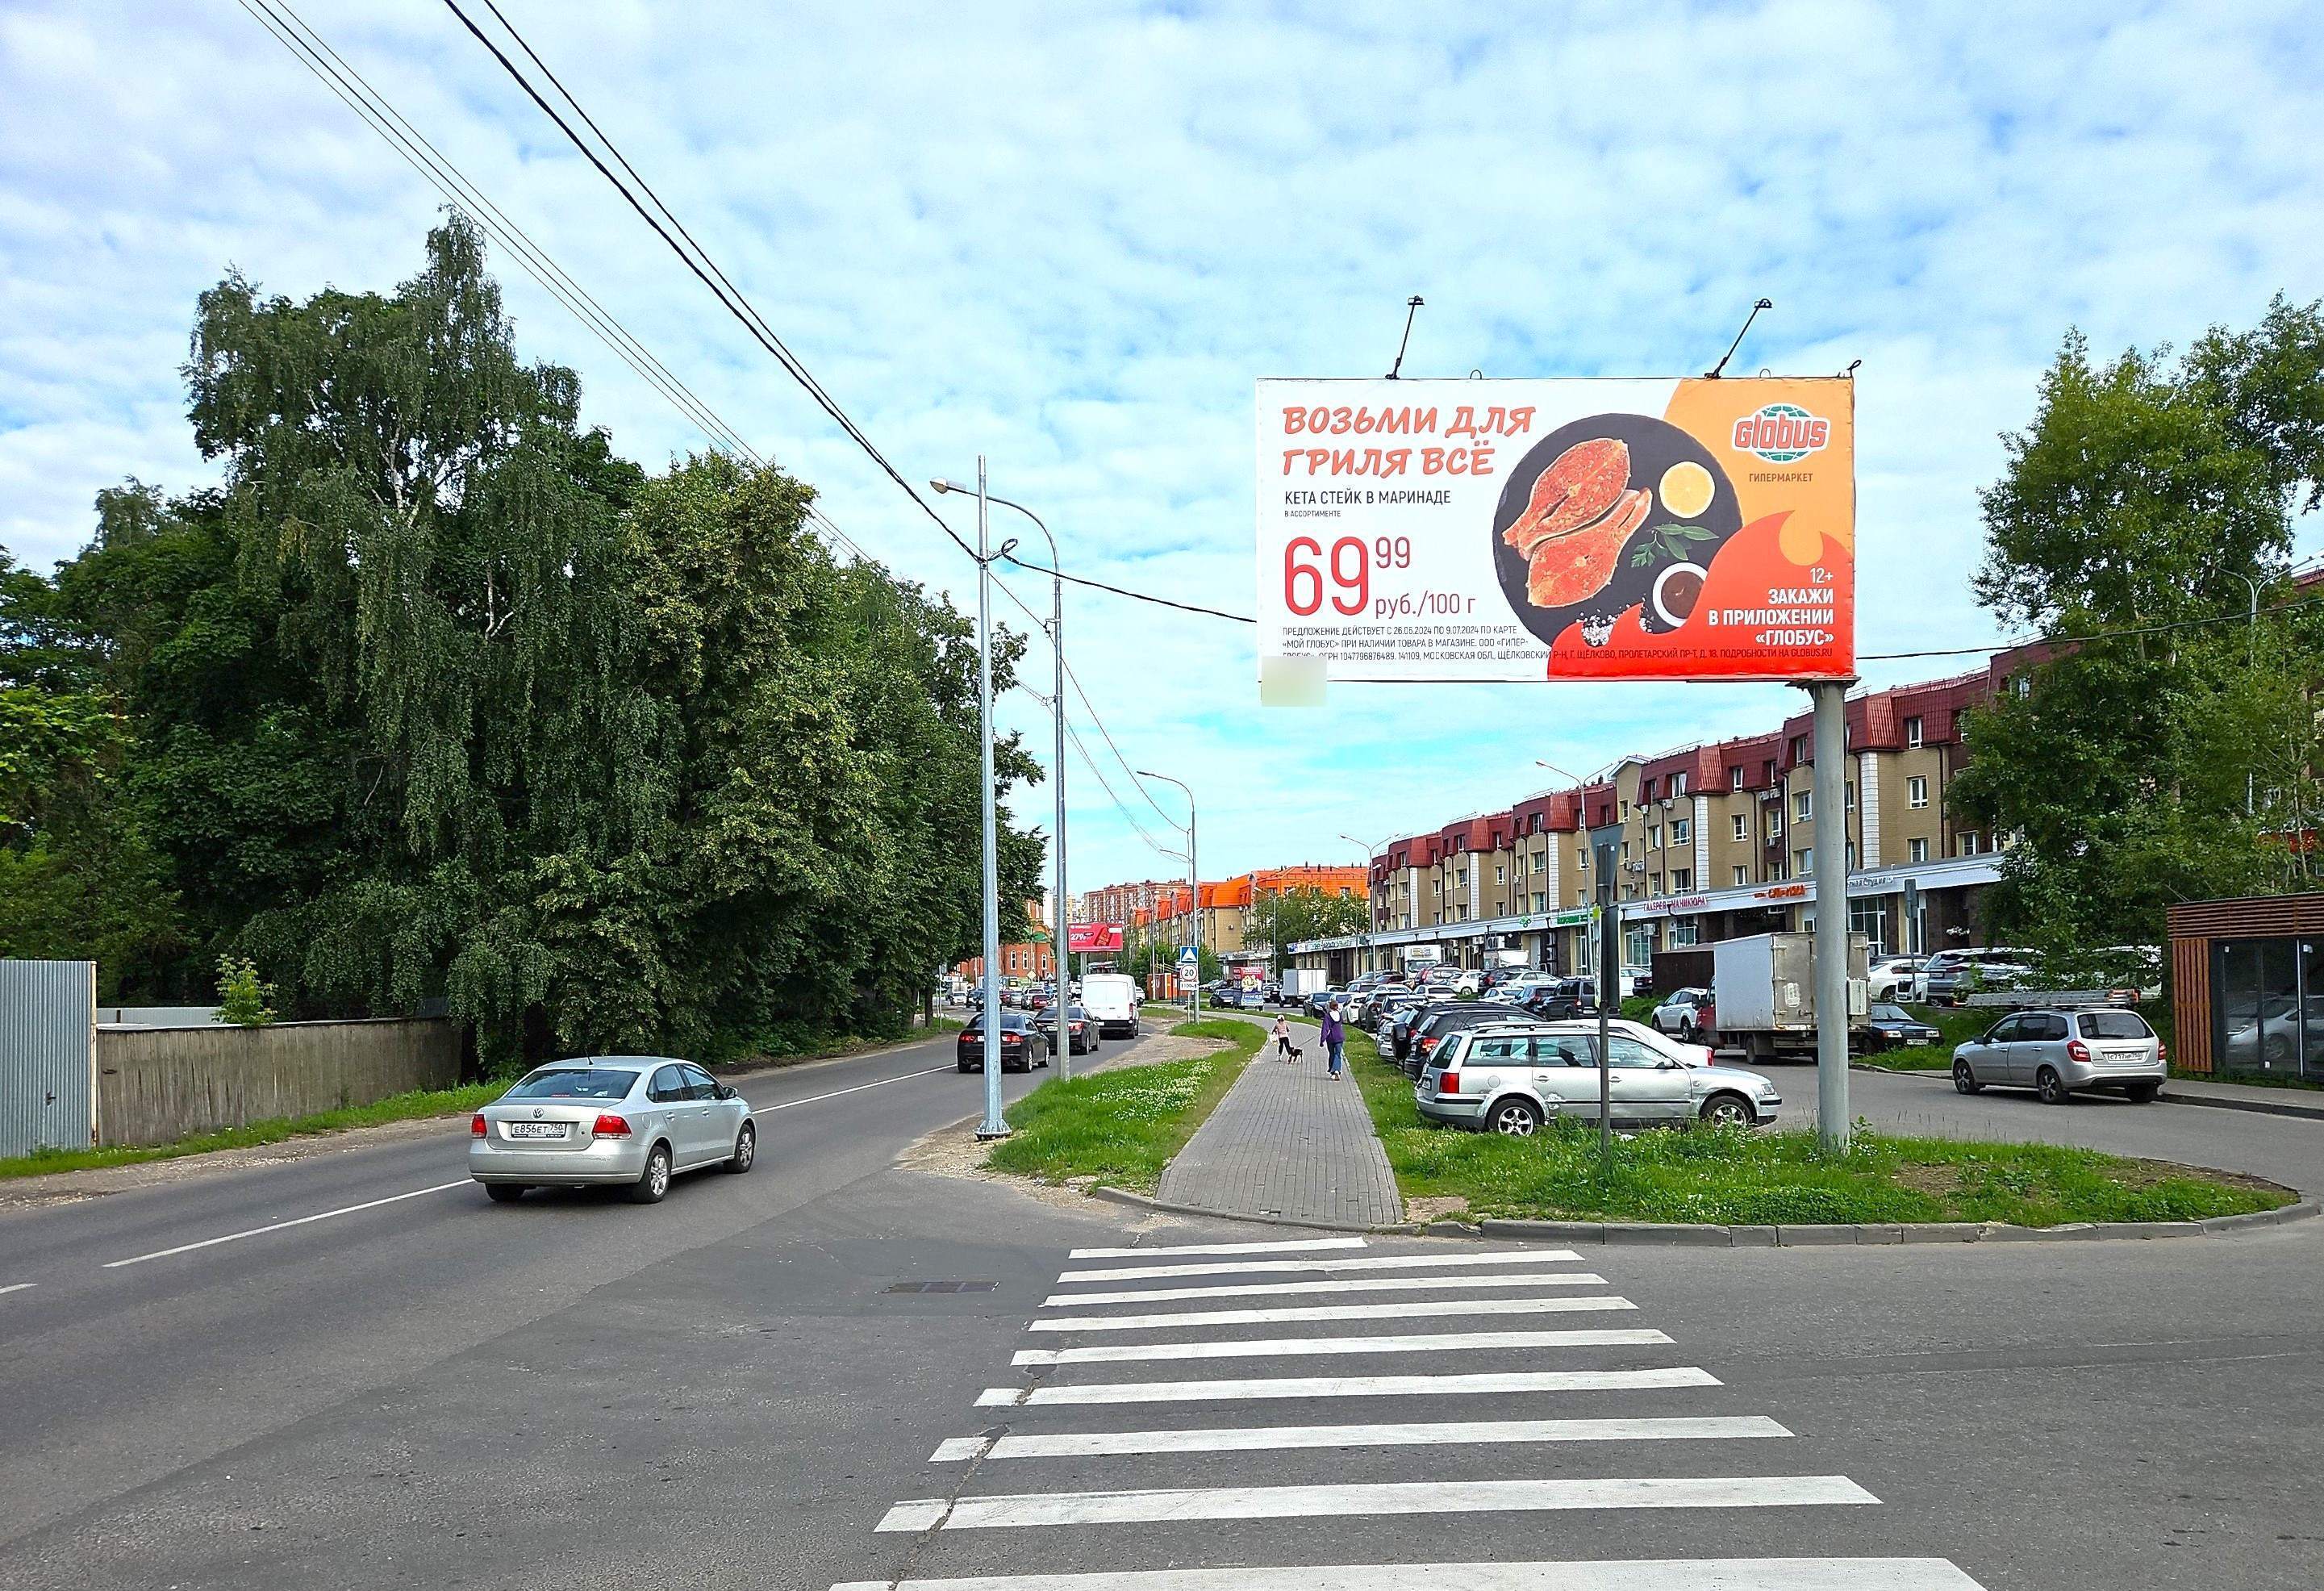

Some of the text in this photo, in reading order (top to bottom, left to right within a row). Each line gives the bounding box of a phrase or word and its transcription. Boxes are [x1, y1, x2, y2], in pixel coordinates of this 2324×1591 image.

[1283, 406, 1537, 439] ВОЗЬМИ ДЛЯ
[1283, 441, 1496, 478] ГРИЛЯ ВСЁ
[1749, 473, 1813, 482] ГИПЕРМАРКЕТ
[1285, 487, 1451, 506] КЕТА СТЕЙК В МАРИНАДЕ
[1284, 510, 1341, 518] В АССОРТИМЕНТЕ
[1284, 536, 1411, 616] 69 99
[1809, 567, 1834, 583] 12+
[1767, 587, 1834, 605] ЗАКАЖИ
[1467, 598, 1476, 614] г
[1709, 608, 1834, 626] В ПРИЛОЖЕНИИ
[1283, 627, 1340, 637] ПРЕДЛОЖЕНИЕ
[1341, 625, 1385, 637] ДЕЙСТВУЕТ
[1387, 626, 1392, 635] С
[1433, 626, 1444, 635] ПО
[1446, 625, 1479, 635] 9.07.2024
[1480, 625, 1492, 634] ПО
[1493, 625, 1517, 634] КАРТЕ
[1754, 628, 1834, 645] «ГЛОБУС»
[1282, 638, 1304, 649] «МОЙ
[1306, 639, 1340, 649] ГЛОБУС»
[1341, 639, 1357, 648] ПРИ
[1358, 639, 1396, 648] НАЛИЧИИ
[1397, 638, 1426, 648] ТОВАРА
[1428, 638, 1433, 648] В
[1479, 638, 1495, 647] ООО
[1423, 651, 1475, 660] МОСКОВСКАЯ
[1619, 647, 1678, 659] ПРОЛЕТАРСКИЙ
[1720, 649, 1777, 658] ПОДРОБНОСТИ
[1778, 649, 1789, 658] НА
[1791, 648, 1833, 658] GLOBUS.RU
[1184, 968, 1194, 977] 20
